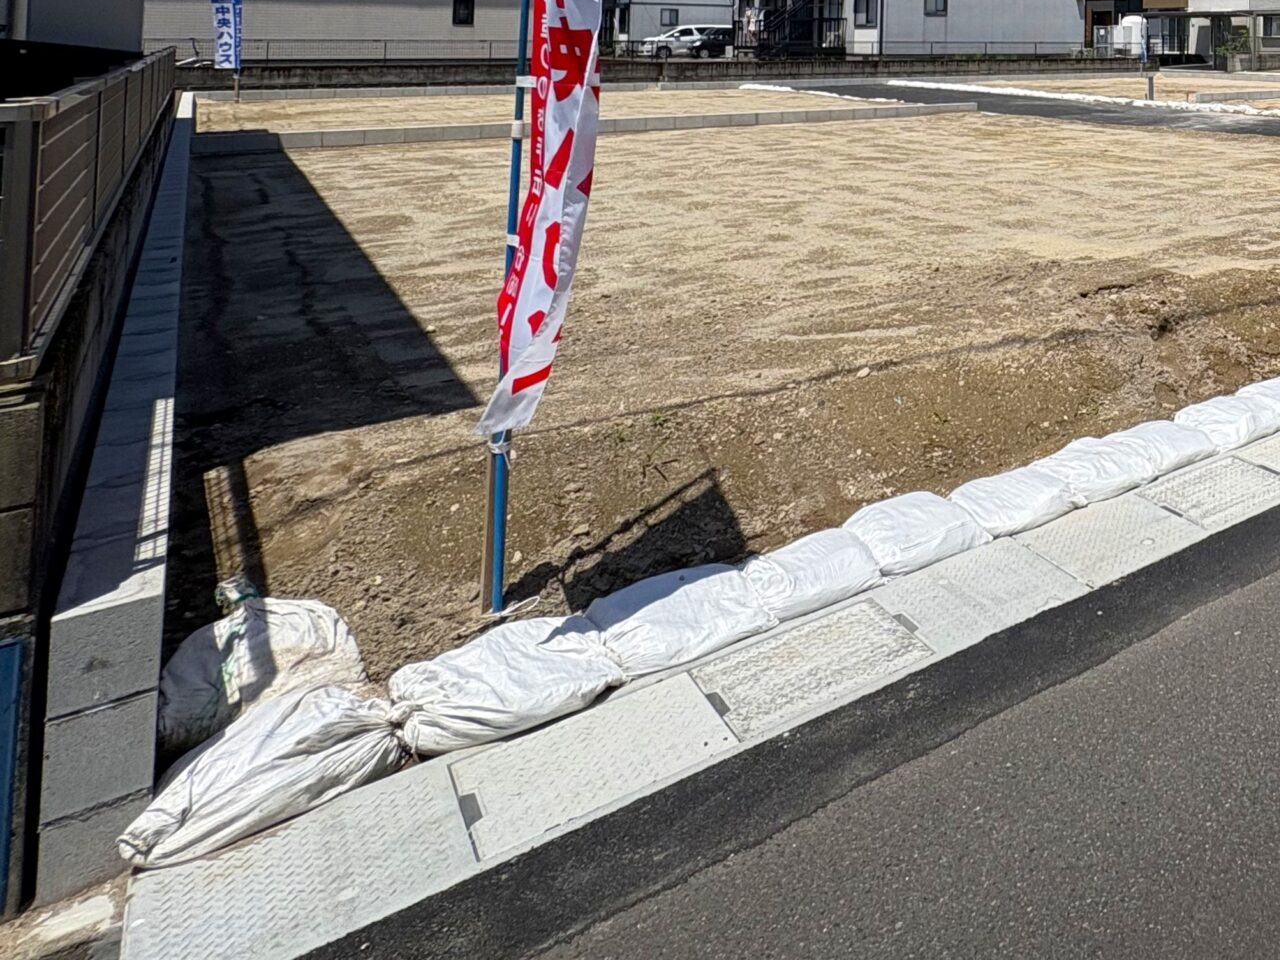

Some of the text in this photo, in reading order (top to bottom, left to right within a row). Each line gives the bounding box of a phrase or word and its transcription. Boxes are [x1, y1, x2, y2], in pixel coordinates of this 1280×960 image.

[215, 5, 233, 65] 中央ハウス
